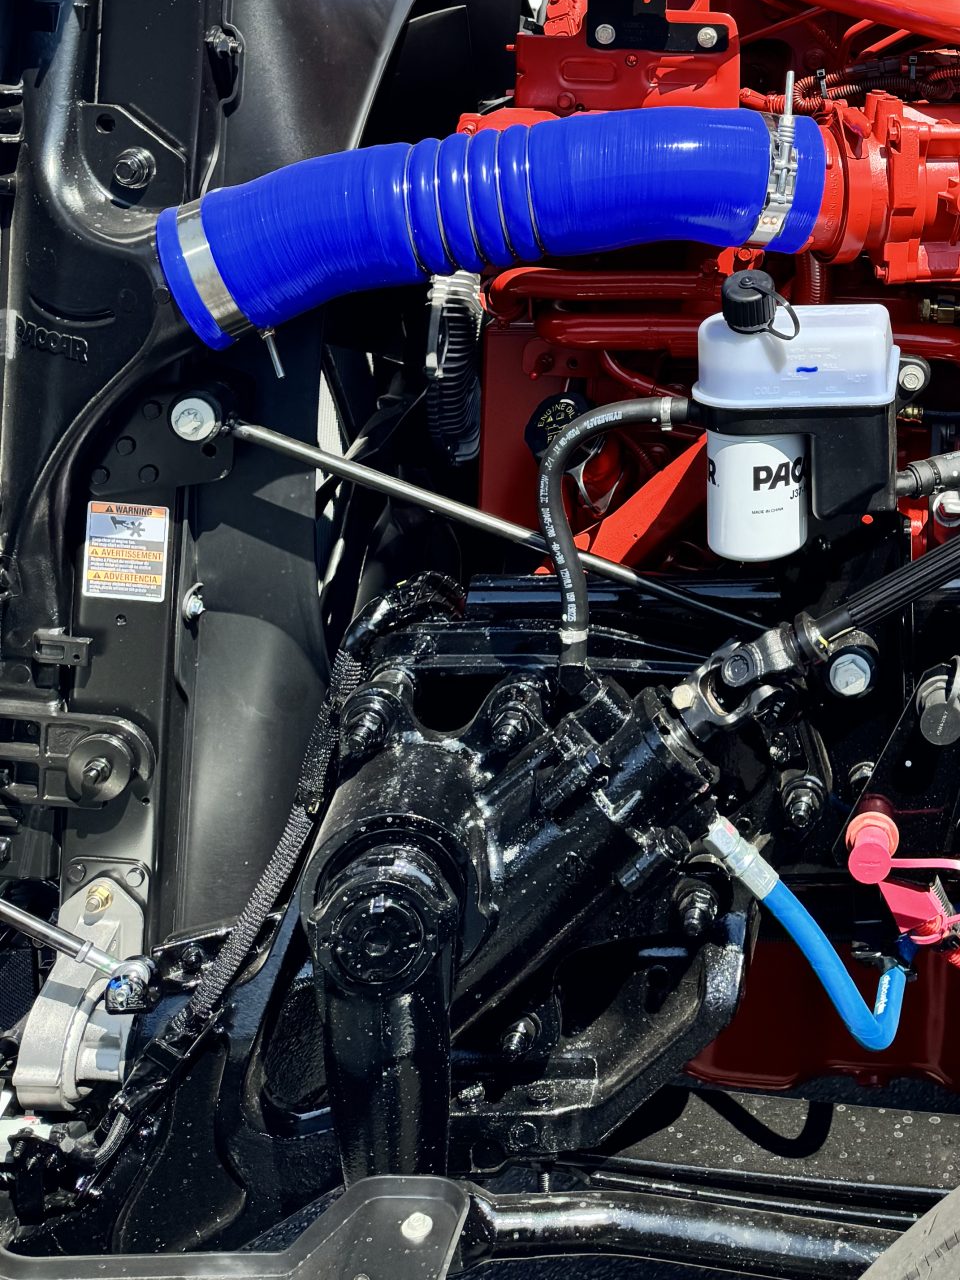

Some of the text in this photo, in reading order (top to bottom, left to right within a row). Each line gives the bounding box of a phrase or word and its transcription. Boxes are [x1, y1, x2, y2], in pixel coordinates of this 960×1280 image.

[538, 403, 576, 427] ENGINE OIL
[115, 505, 153, 516] WARNING
[101, 548, 162, 560] AVERTISSEMENT
[104, 572, 157, 584] ADVERTENCIA
